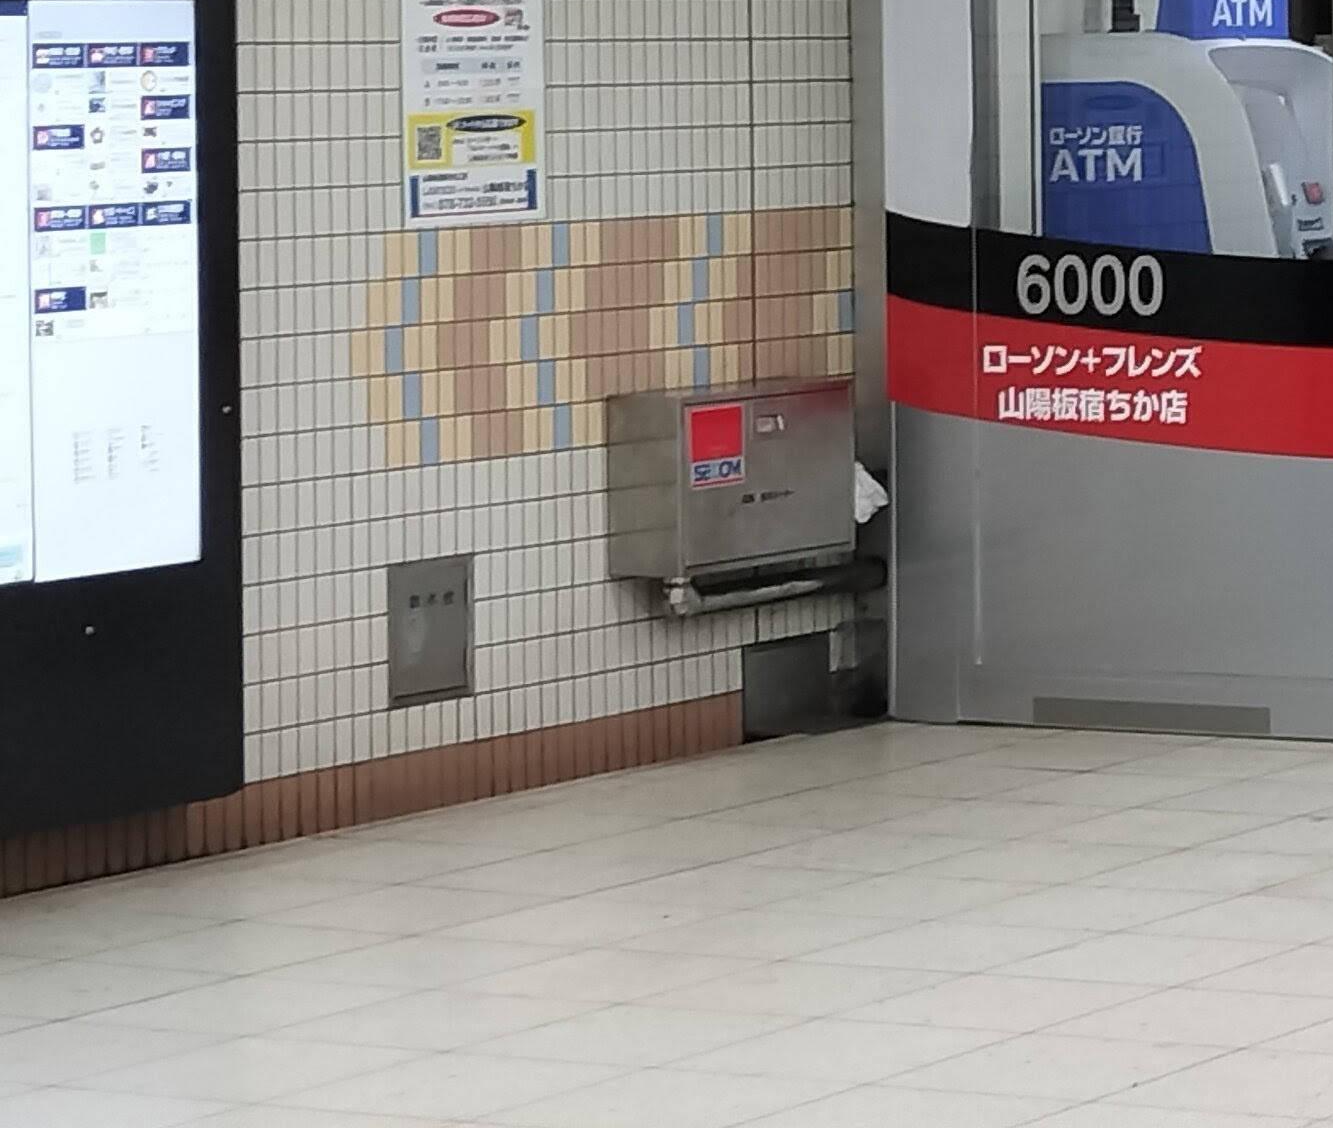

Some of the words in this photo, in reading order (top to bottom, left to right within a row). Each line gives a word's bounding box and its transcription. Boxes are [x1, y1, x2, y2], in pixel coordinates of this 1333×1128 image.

[1049, 125, 1142, 145] ローソン銀行
[1049, 148, 1142, 182] ATM
[1017, 254, 1163, 316] 6000
[998, 386, 1187, 423] 山陽板宿ちか店
[694, 460, 741, 481] SEOM
